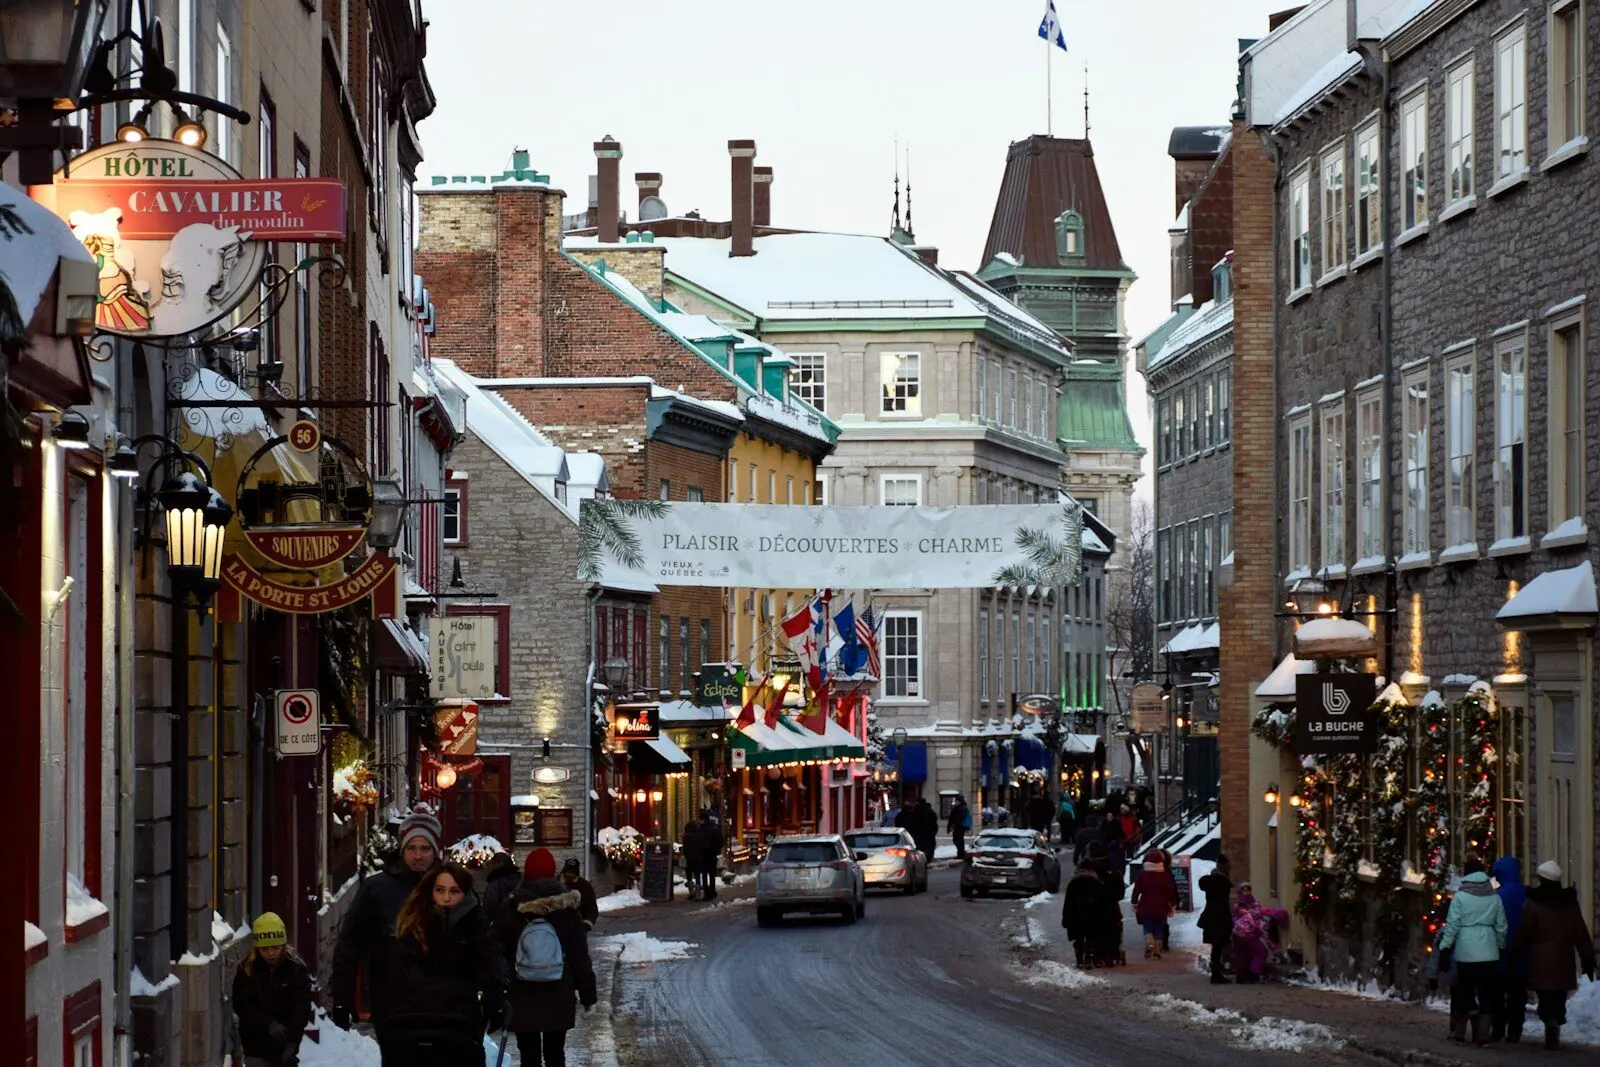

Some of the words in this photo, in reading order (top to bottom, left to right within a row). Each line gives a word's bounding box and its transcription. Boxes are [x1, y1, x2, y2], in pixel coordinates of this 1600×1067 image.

[104, 152, 193, 177] HÔTEL
[128, 190, 283, 212] CAVALIER
[211, 213, 235, 229] du
[242, 210, 304, 228] moulin
[296, 428, 311, 444] 56
[272, 535, 340, 561] SOUVENIRS
[662, 534, 740, 552] PLAISIR
[758, 533, 899, 553] DÉCOUVERTES
[918, 537, 1003, 553] CHARME
[660, 560, 693, 569] VIEUX
[226, 562, 247, 586] LA
[247, 582, 305, 607] PORTE
[450, 622, 475, 630] Hôtel
[280, 735, 289, 744] DE
[291, 735, 299, 744] CE
